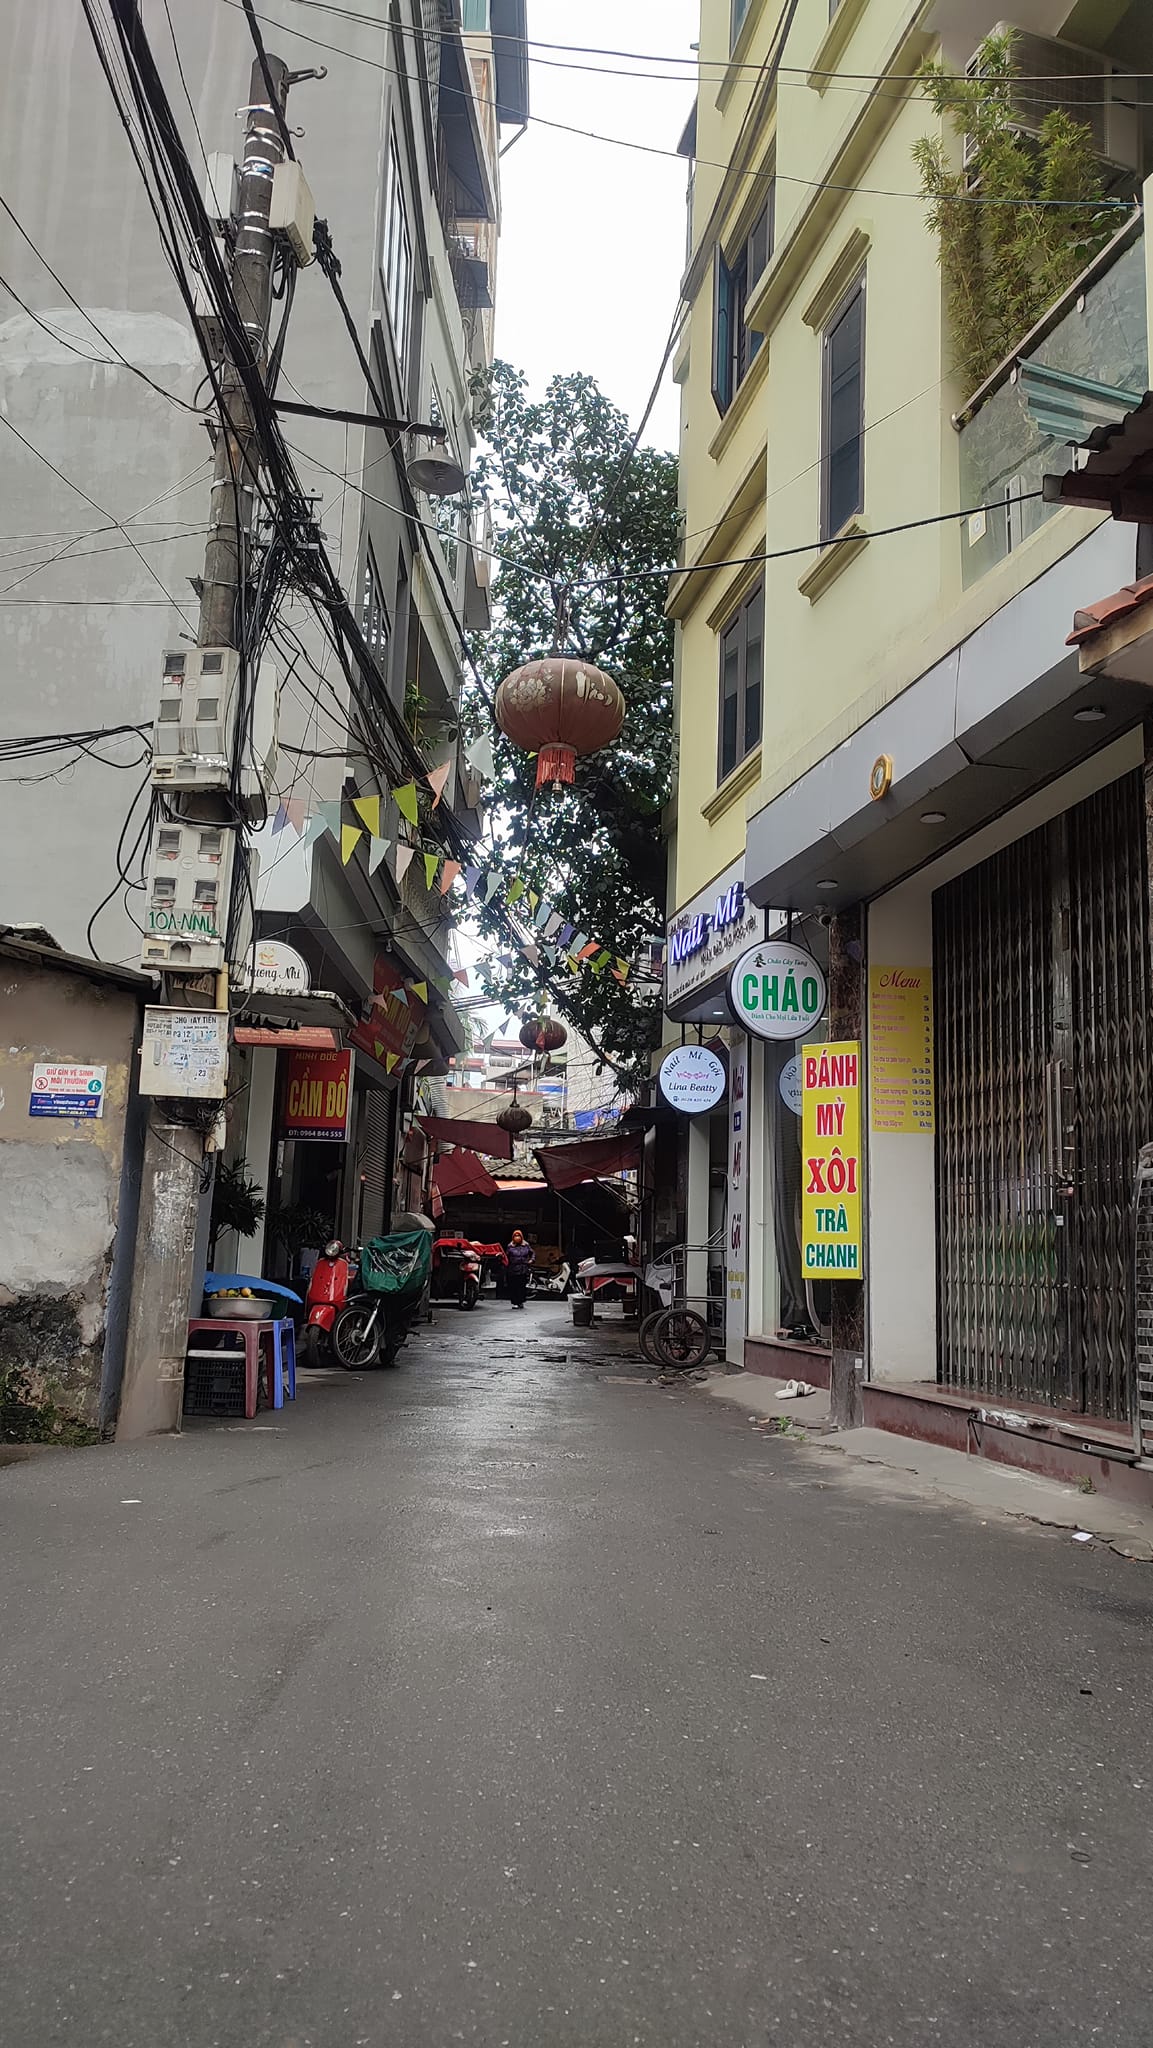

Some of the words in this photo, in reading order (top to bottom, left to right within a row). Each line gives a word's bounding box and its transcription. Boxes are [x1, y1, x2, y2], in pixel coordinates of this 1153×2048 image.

[671, 913, 704, 966] Nail
[713, 882, 739, 932] Mi
[742, 968, 818, 1014] CHÁO
[880, 969, 921, 989] Menu
[664, 1056, 680, 1077] Nail
[689, 1050, 702, 1060] Mi
[708, 1061, 723, 1077] Gội
[806, 1049, 857, 1089] BÁNH
[289, 1066, 323, 1117] CẦM
[326, 1068, 347, 1118] ĐỒ
[668, 1082, 687, 1091] Lina
[690, 1082, 718, 1094] Beatty
[817, 1096, 846, 1136] MỲ
[300, 1129, 316, 1137] 0964
[330, 1130, 343, 1138] 555
[806, 1146, 857, 1194] XÔI
[815, 1203, 848, 1232] TRÀ
[806, 1243, 858, 1268] CHANH
